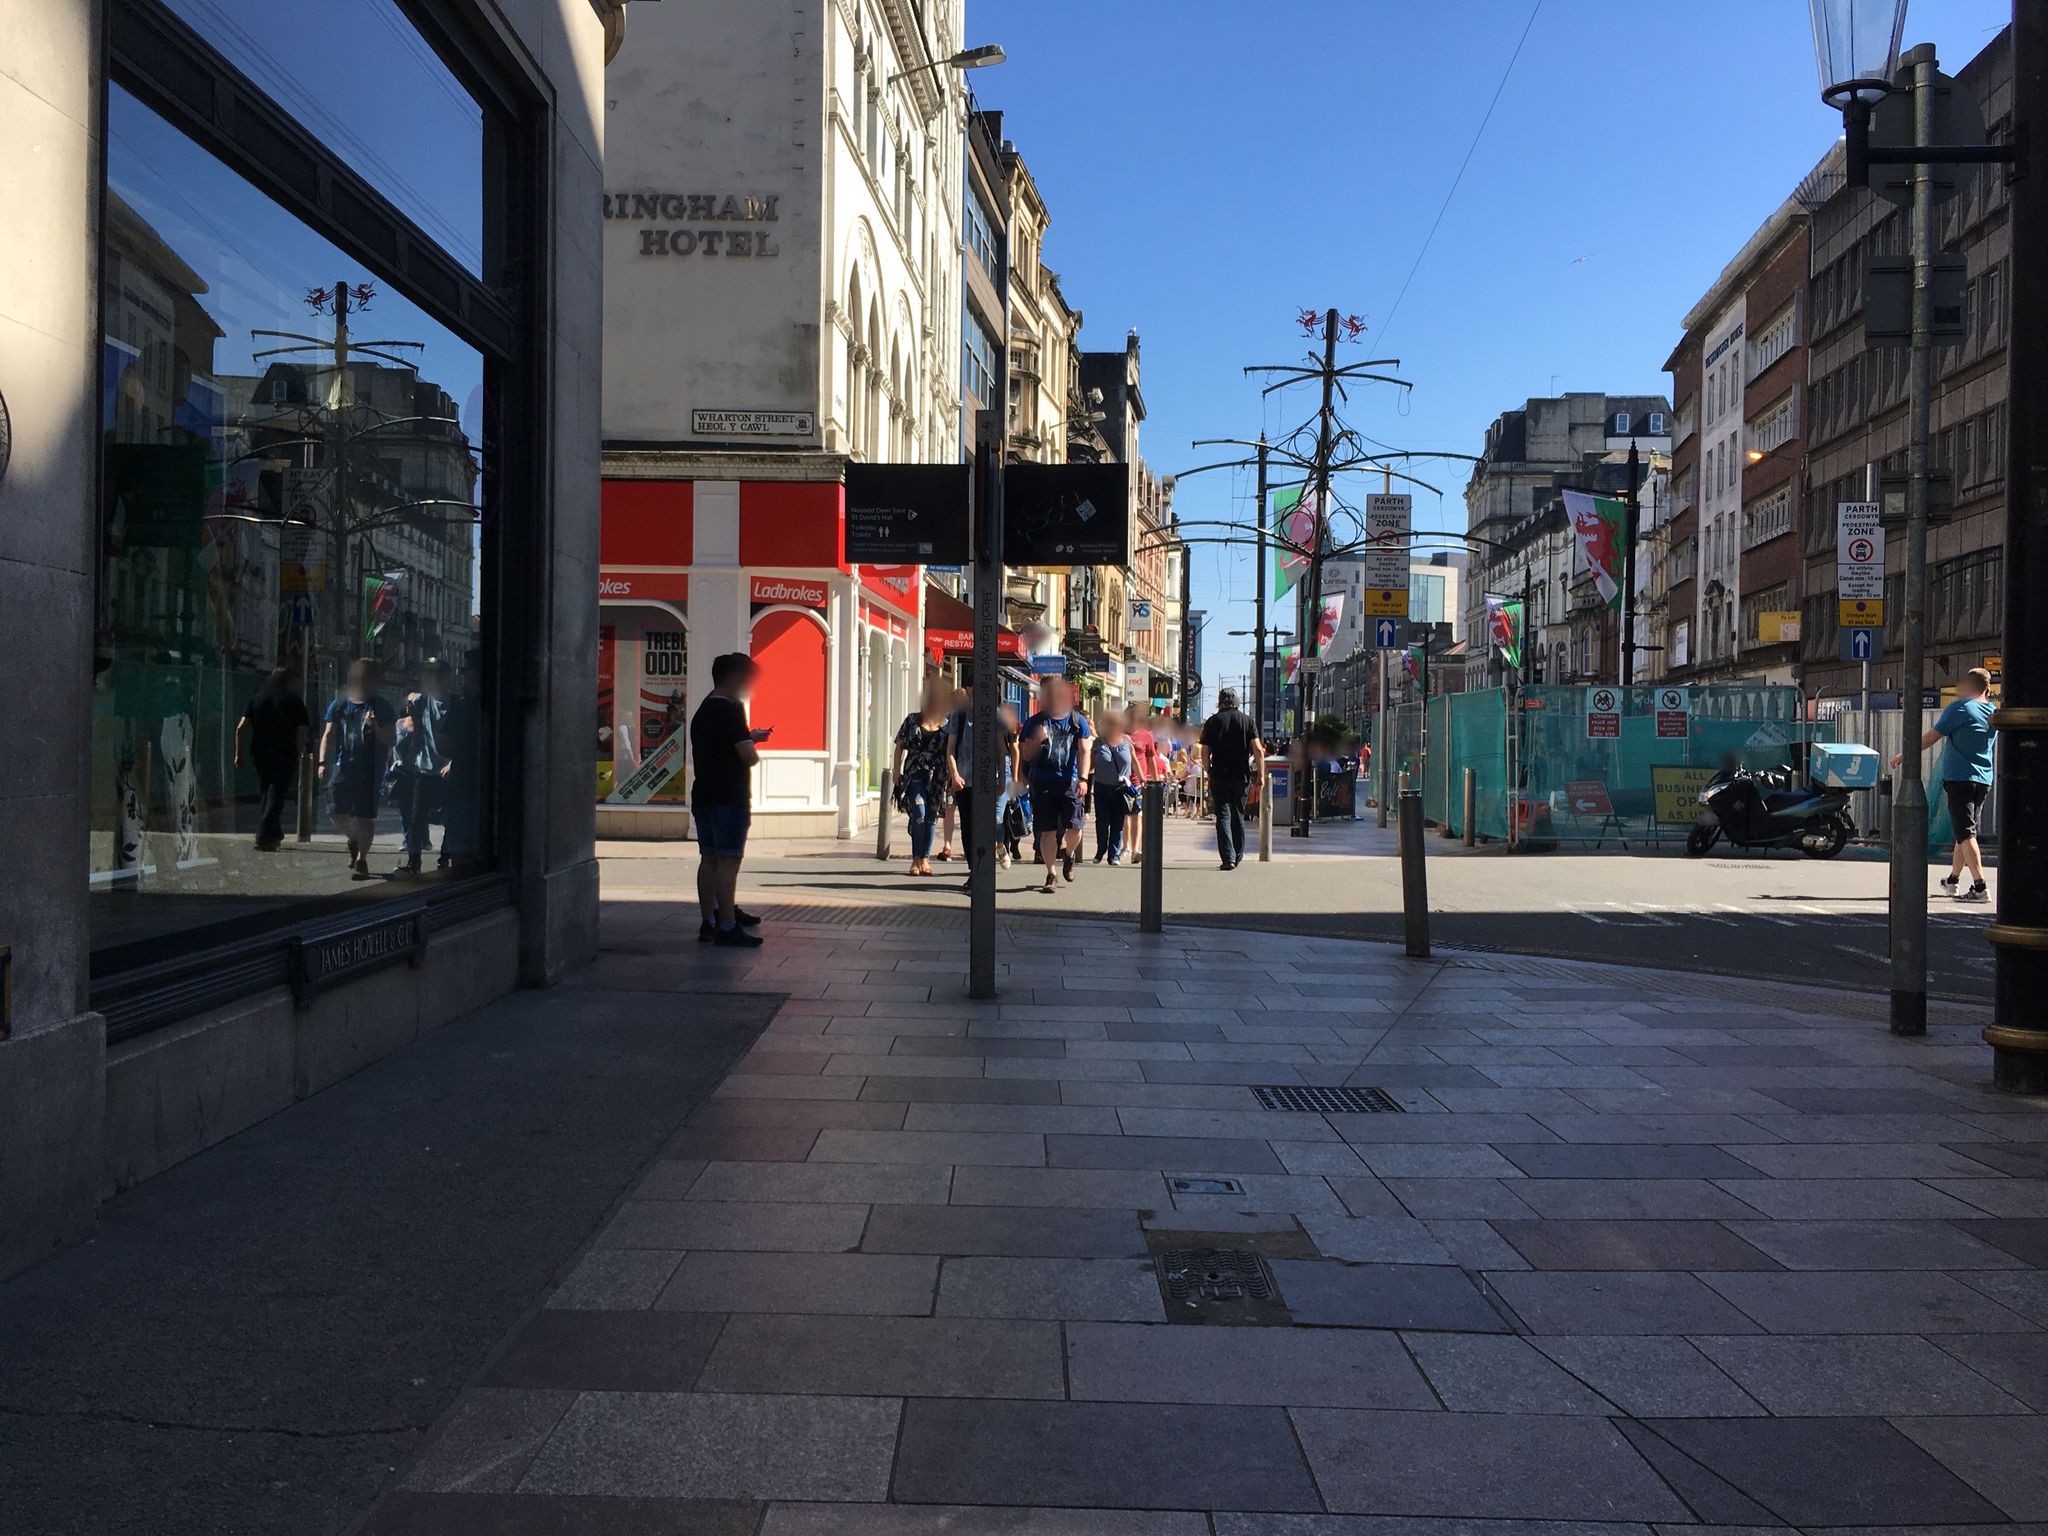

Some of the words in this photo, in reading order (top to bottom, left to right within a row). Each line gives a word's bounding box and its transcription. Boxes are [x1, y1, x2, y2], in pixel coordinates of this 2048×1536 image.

[640, 230, 779, 257] HOTEL
[698, 413, 752, 422] WHARTON
[755, 415, 796, 423] STREET
[698, 422, 726, 431] HEOL
[729, 423, 737, 431] Y
[740, 423, 769, 432] CAWL
[1374, 497, 1404, 505] PARTH
[1846, 505, 1878, 513] PARTH
[1848, 528, 1875, 536] ZONE
[754, 582, 823, 601] Ladbrokes
[981, 592, 993, 621] Heol
[958, 632, 975, 640] BAR
[979, 625, 993, 669] Eglwys
[980, 673, 992, 697] Fair
[1129, 677, 1143, 685] red
[980, 705, 992, 717] St
[977, 722, 992, 749] Mary
[979, 757, 992, 795] Street
[1684, 771, 1706, 780] ALL
[1668, 811, 1684, 819] AS
[321, 941, 350, 976] JAMES
[353, 928, 387, 961] HOWELL
